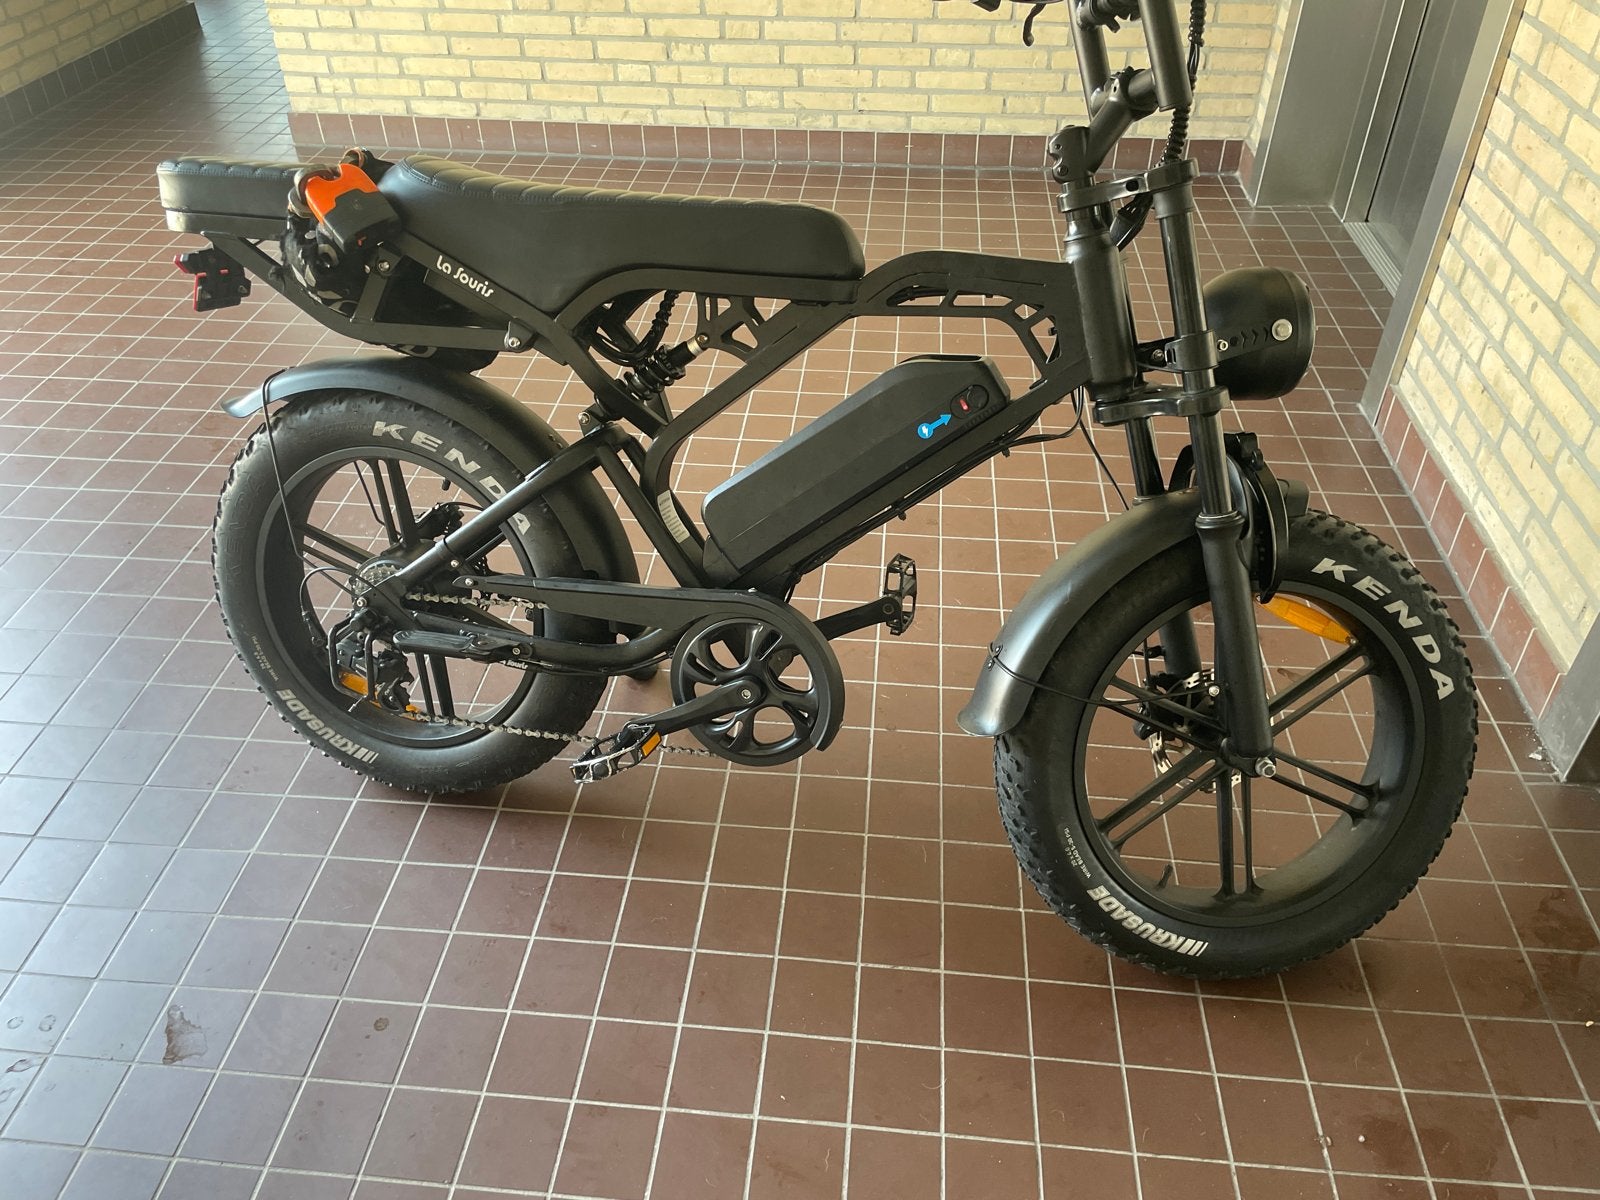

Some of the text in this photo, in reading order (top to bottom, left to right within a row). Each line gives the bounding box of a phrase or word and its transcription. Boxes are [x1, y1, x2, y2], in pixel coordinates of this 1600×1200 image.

[437, 255, 494, 297] La Souris
[372, 421, 531, 535] KENDA
[1311, 557, 1455, 700] KENDA
[276, 689, 361, 756] KRUSADE
[1086, 885, 1186, 951] KRUSADE
